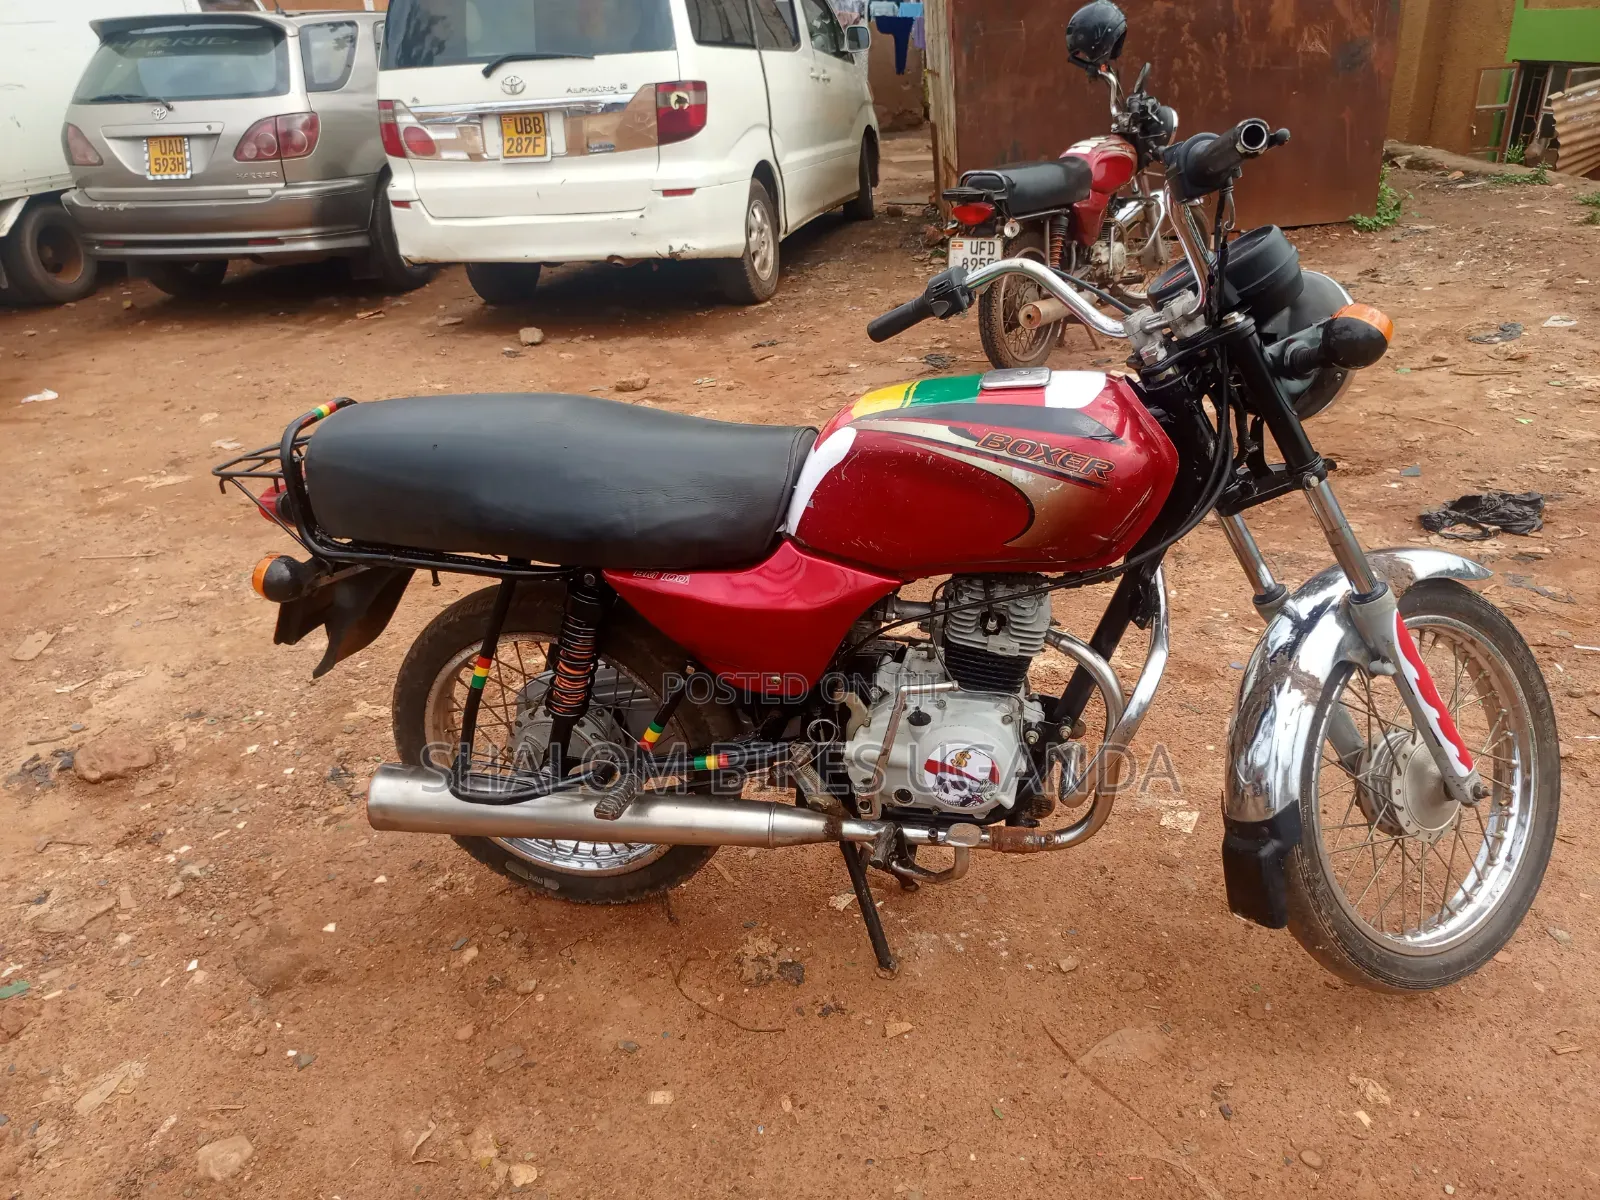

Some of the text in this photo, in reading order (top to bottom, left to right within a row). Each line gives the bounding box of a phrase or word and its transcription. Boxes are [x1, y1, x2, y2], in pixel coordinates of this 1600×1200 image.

[513, 116, 543, 135] UBB
[159, 139, 184, 156] UAU
[506, 136, 542, 154] 287F
[154, 156, 185, 173] 593H
[970, 240, 996, 256] UFD
[976, 431, 1116, 481] BOXER
